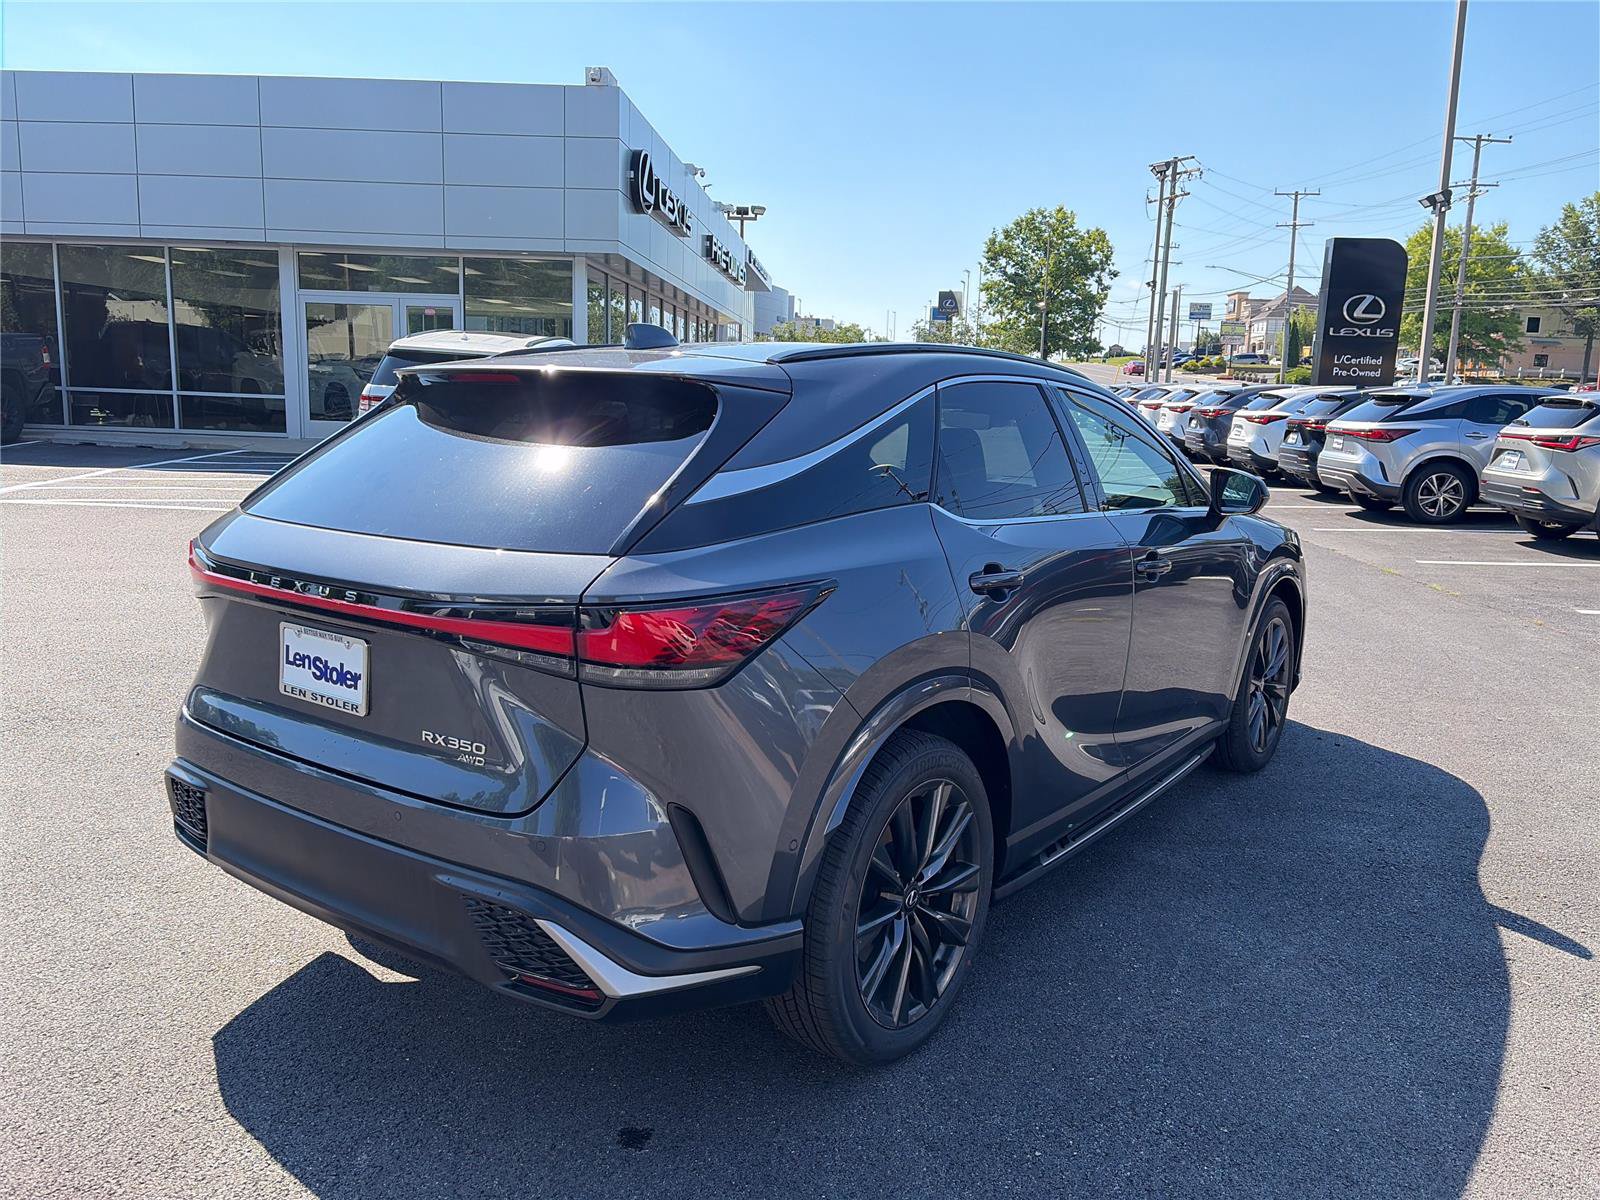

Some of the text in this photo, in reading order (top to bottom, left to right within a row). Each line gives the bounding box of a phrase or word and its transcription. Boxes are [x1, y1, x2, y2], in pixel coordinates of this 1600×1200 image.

[656, 178, 692, 236] LEXUS
[1329, 327, 1394, 338] LEXUS
[1334, 354, 1383, 365] L/Certified
[1332, 366, 1382, 378] Pre-Owned
[250, 572, 357, 602] LEXUS
[283, 684, 359, 713] LEN STOLER
[421, 730, 486, 755] RX350
[457, 753, 485, 766] AWD
